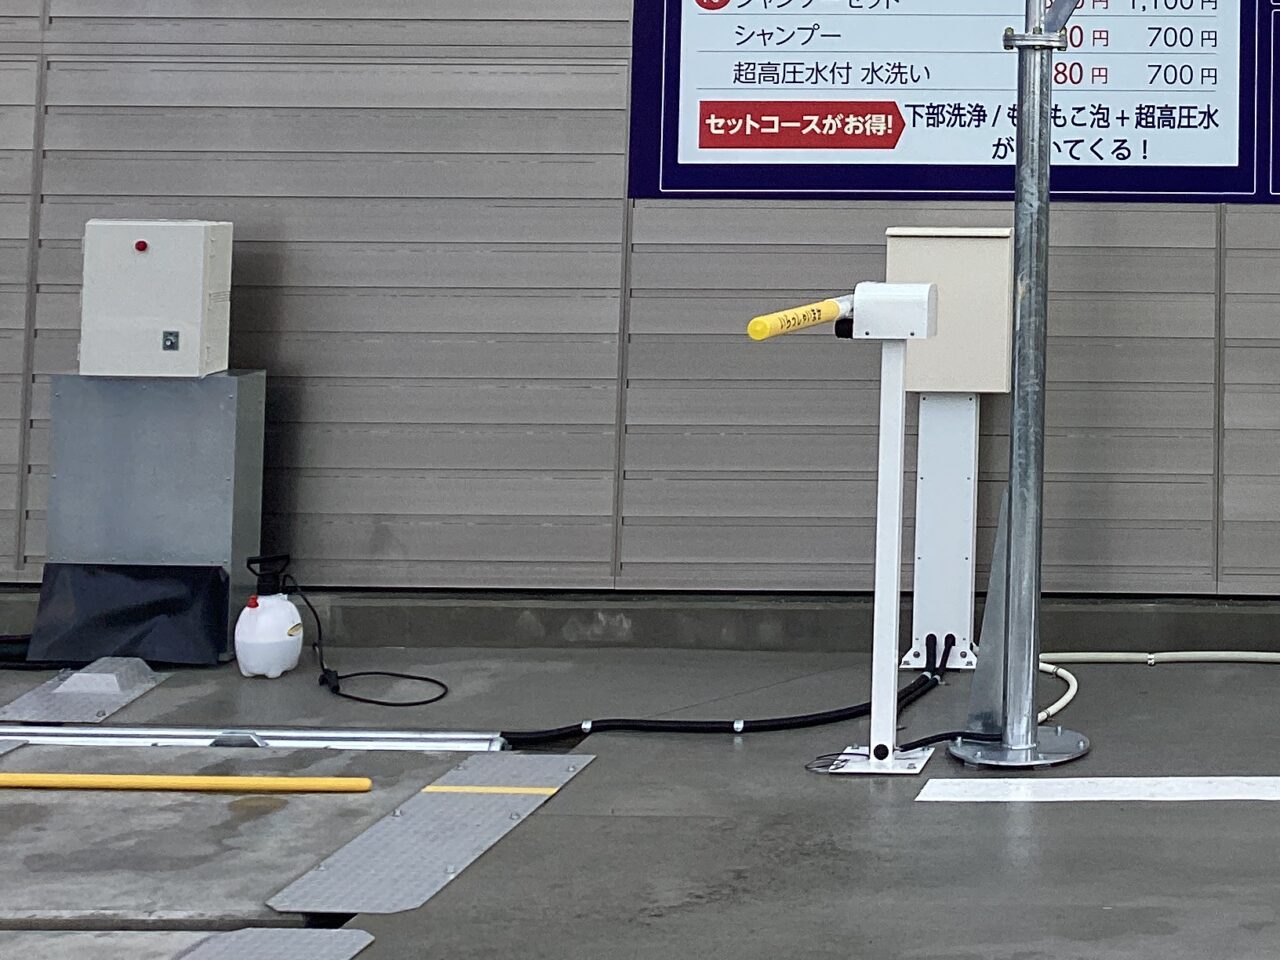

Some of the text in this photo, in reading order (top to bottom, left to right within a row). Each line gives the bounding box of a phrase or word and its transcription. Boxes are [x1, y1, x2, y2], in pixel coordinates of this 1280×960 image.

[735, 23, 842, 46] シャンプー
[1147, 27, 1194, 47] 700
[733, 62, 853, 85] 超高圧水付
[860, 62, 930, 85] 水洗い
[1147, 64, 1194, 85] 700
[705, 113, 893, 136] セットコースがお得!
[904, 103, 988, 129] 下部洗浄
